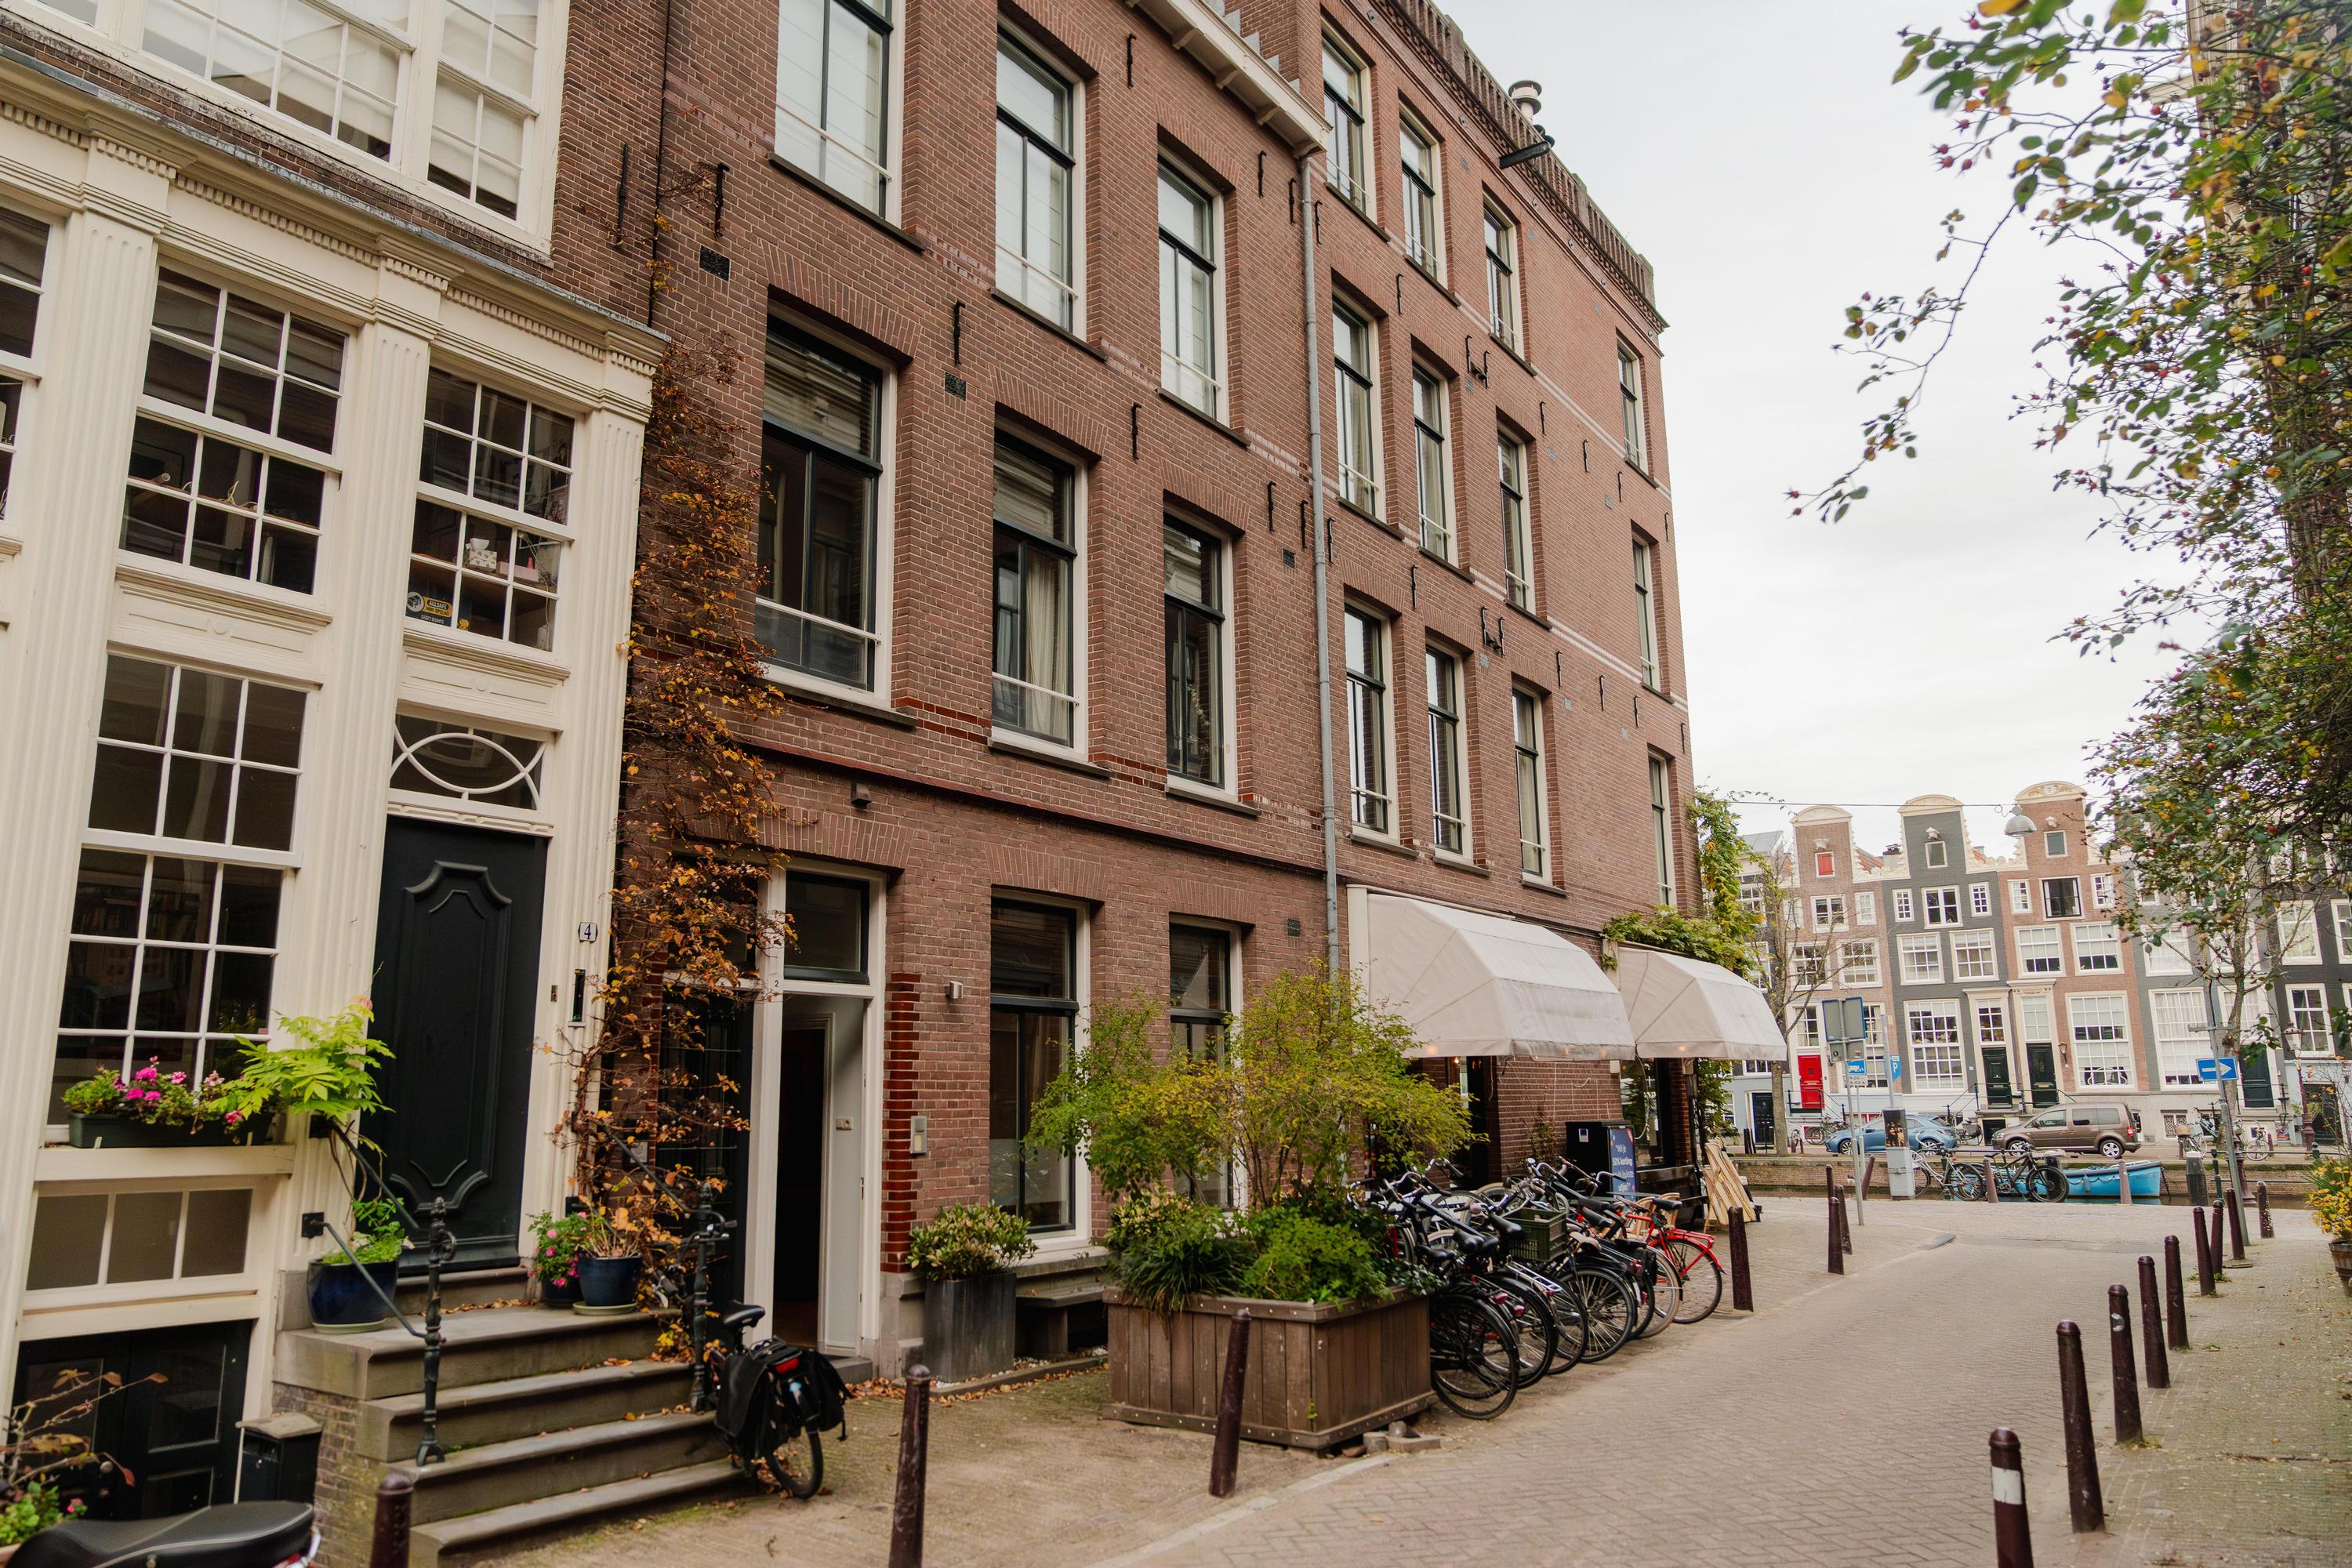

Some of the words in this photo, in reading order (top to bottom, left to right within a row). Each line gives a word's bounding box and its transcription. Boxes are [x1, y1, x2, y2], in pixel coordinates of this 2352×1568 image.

[429, 601, 448, 610] ALLSAFE
[584, 924, 591, 939] 4
[1893, 1062, 1898, 1073] P
